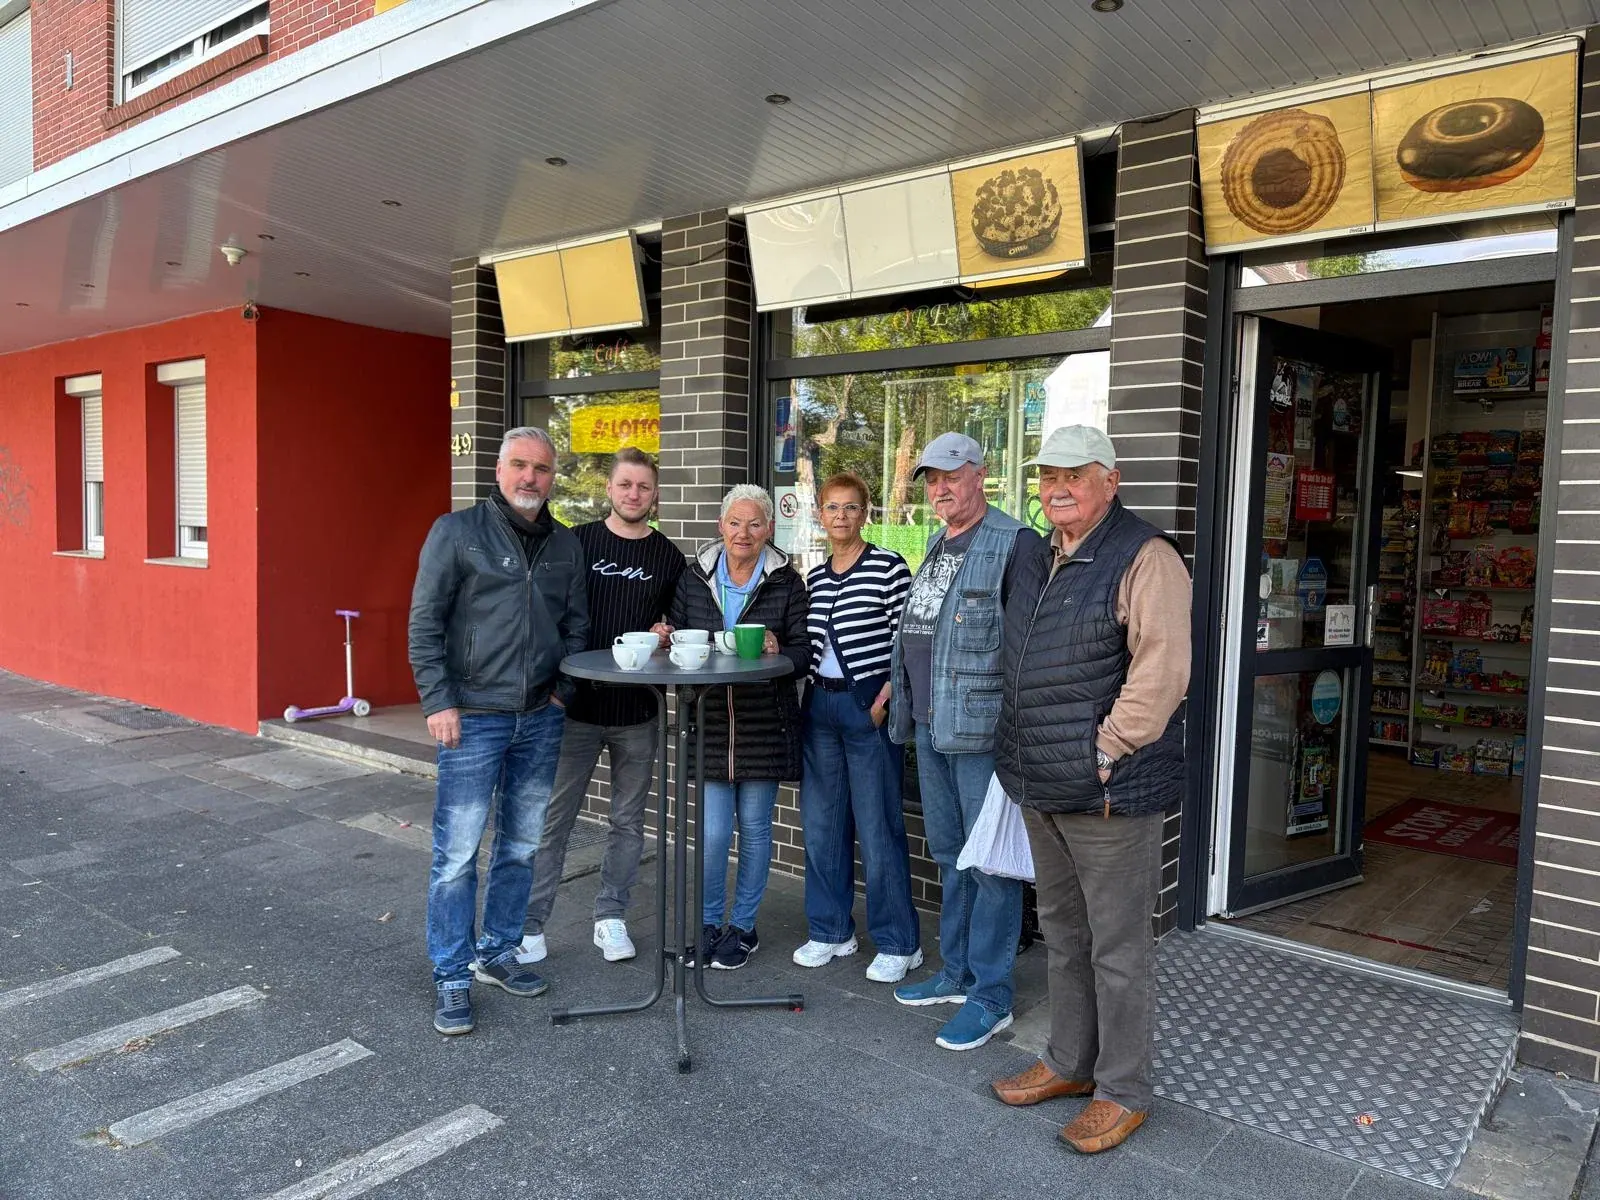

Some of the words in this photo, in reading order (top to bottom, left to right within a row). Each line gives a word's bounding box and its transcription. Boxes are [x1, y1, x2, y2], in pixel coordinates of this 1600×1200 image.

[611, 419, 660, 438] LOTTO
[451, 432, 472, 456] 49
[591, 559, 652, 581] icon
